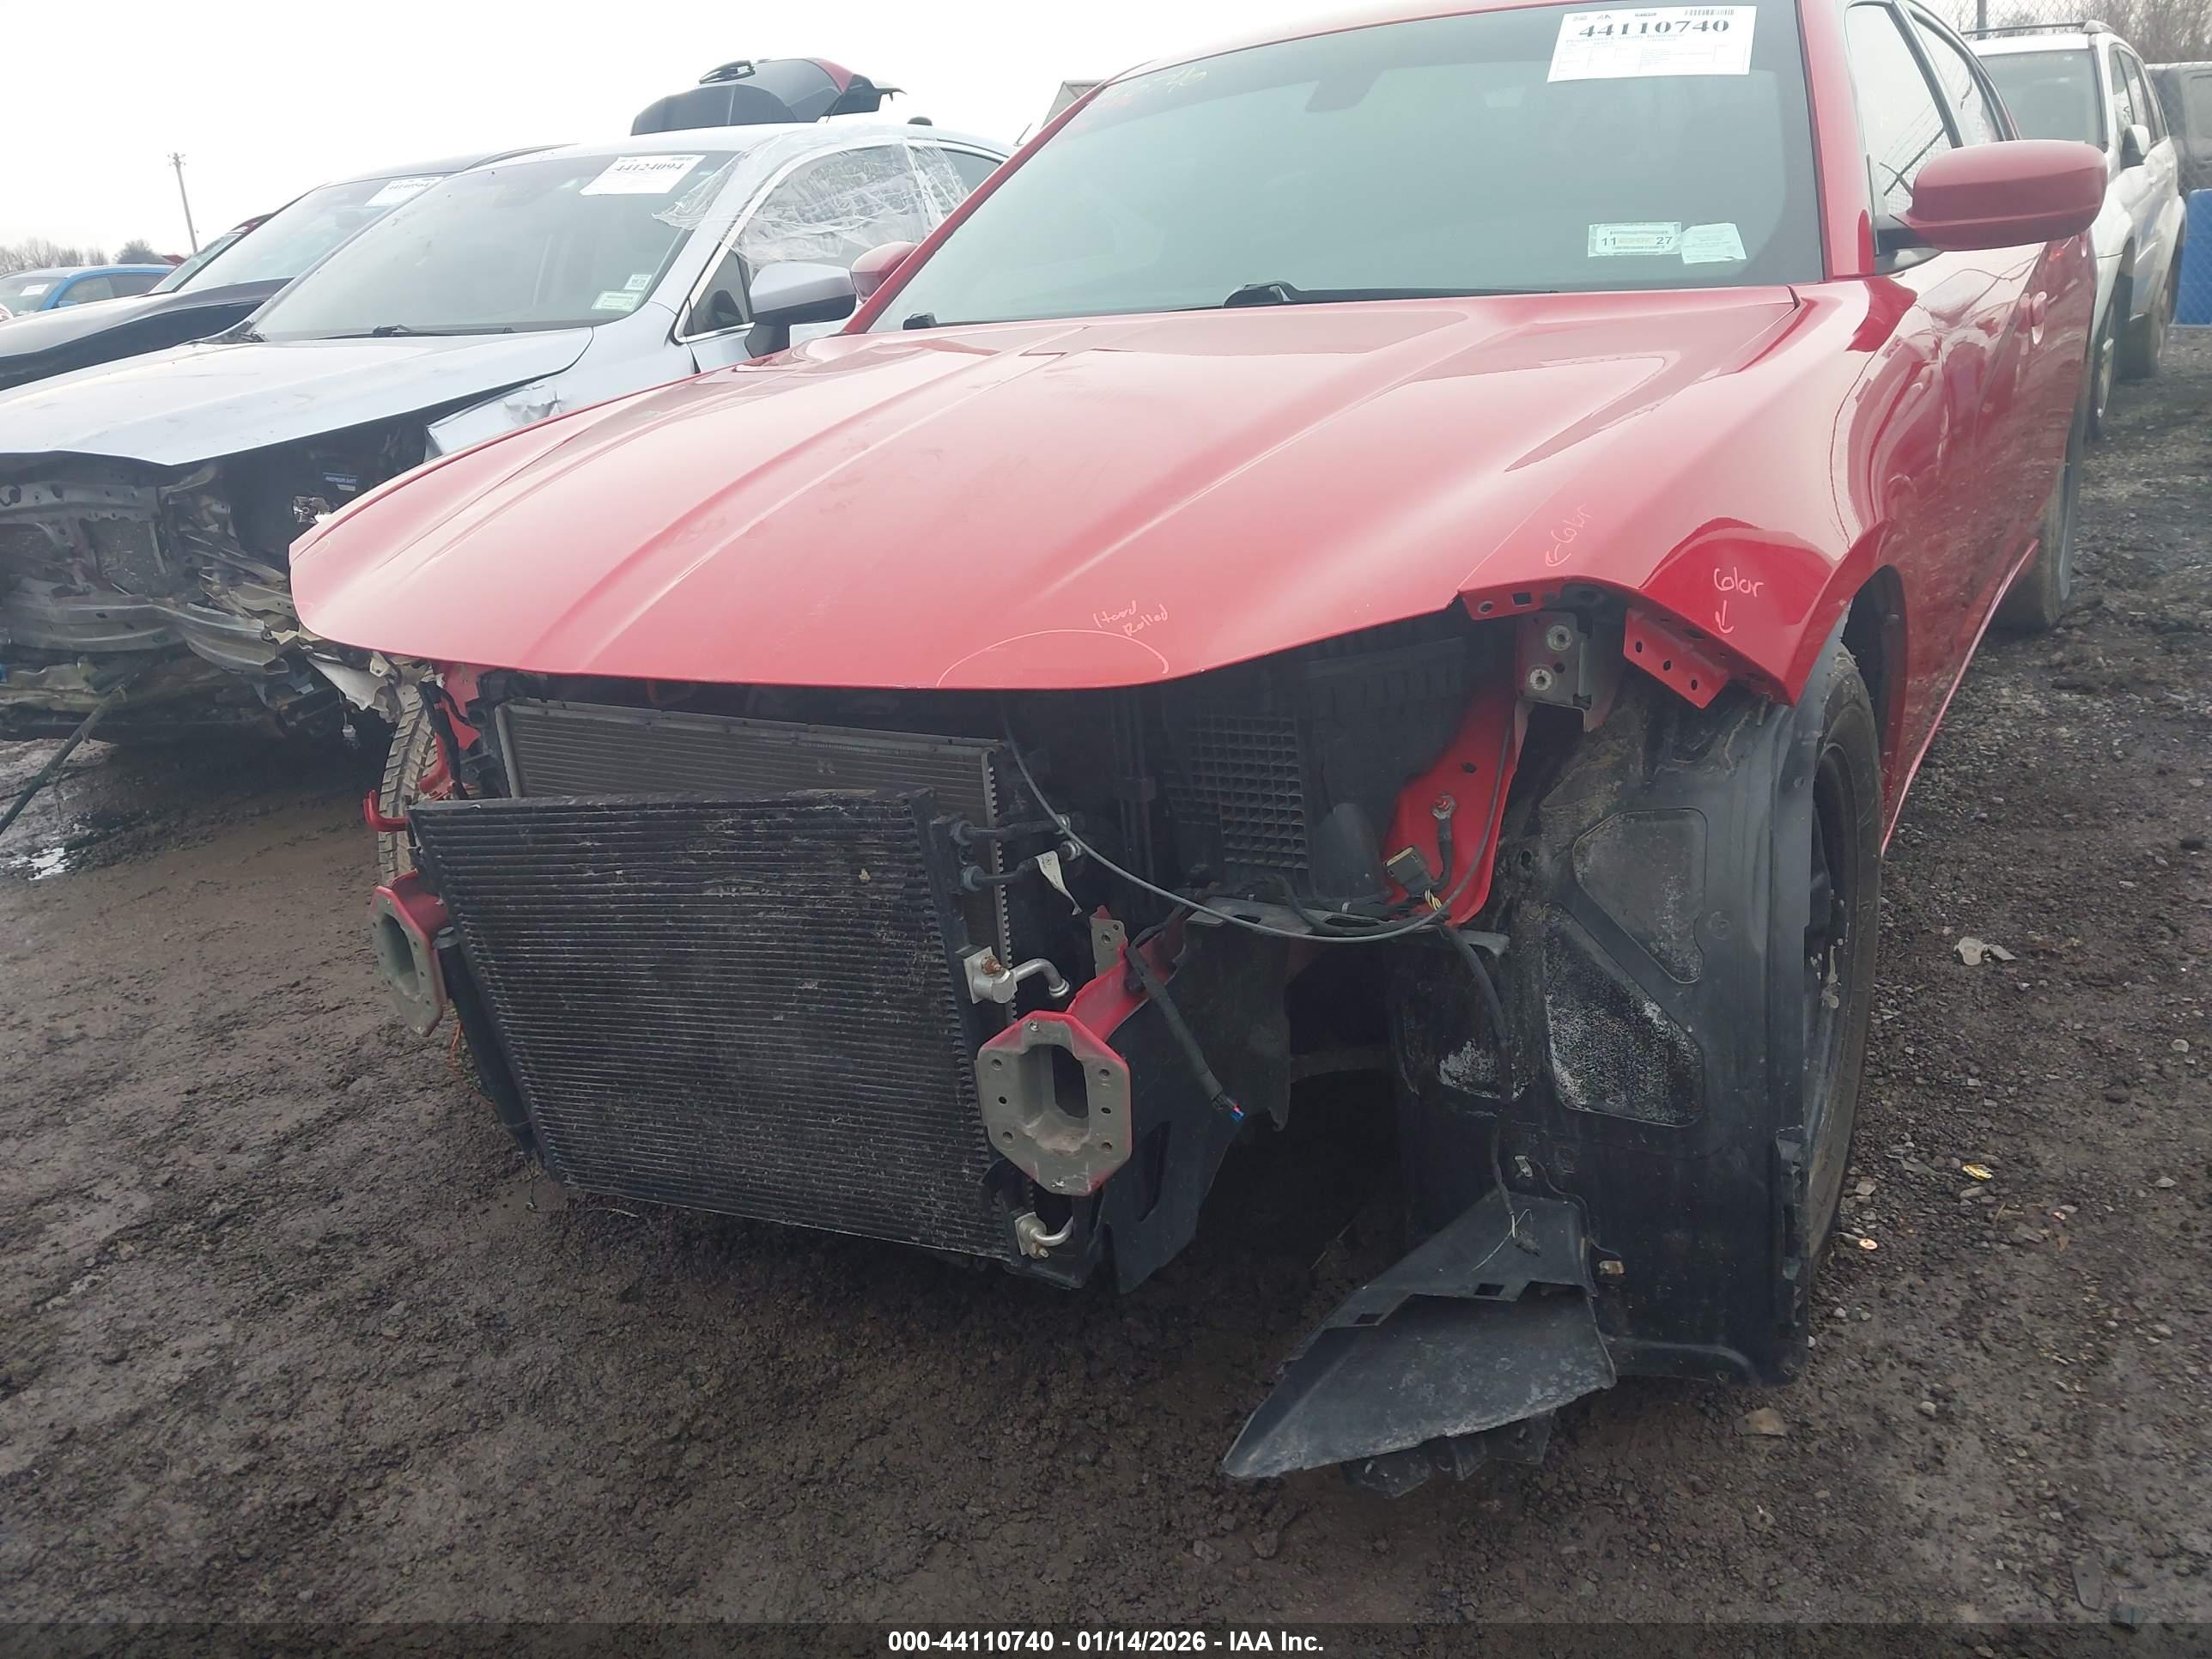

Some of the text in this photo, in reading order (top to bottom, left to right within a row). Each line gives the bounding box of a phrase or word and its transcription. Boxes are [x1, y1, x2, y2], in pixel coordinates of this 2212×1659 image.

[1578, 19, 1729, 38] 44110740
[1601, 236, 1617, 246] 11
[1656, 236, 1673, 245] 27
[1713, 566, 1765, 598] Color
